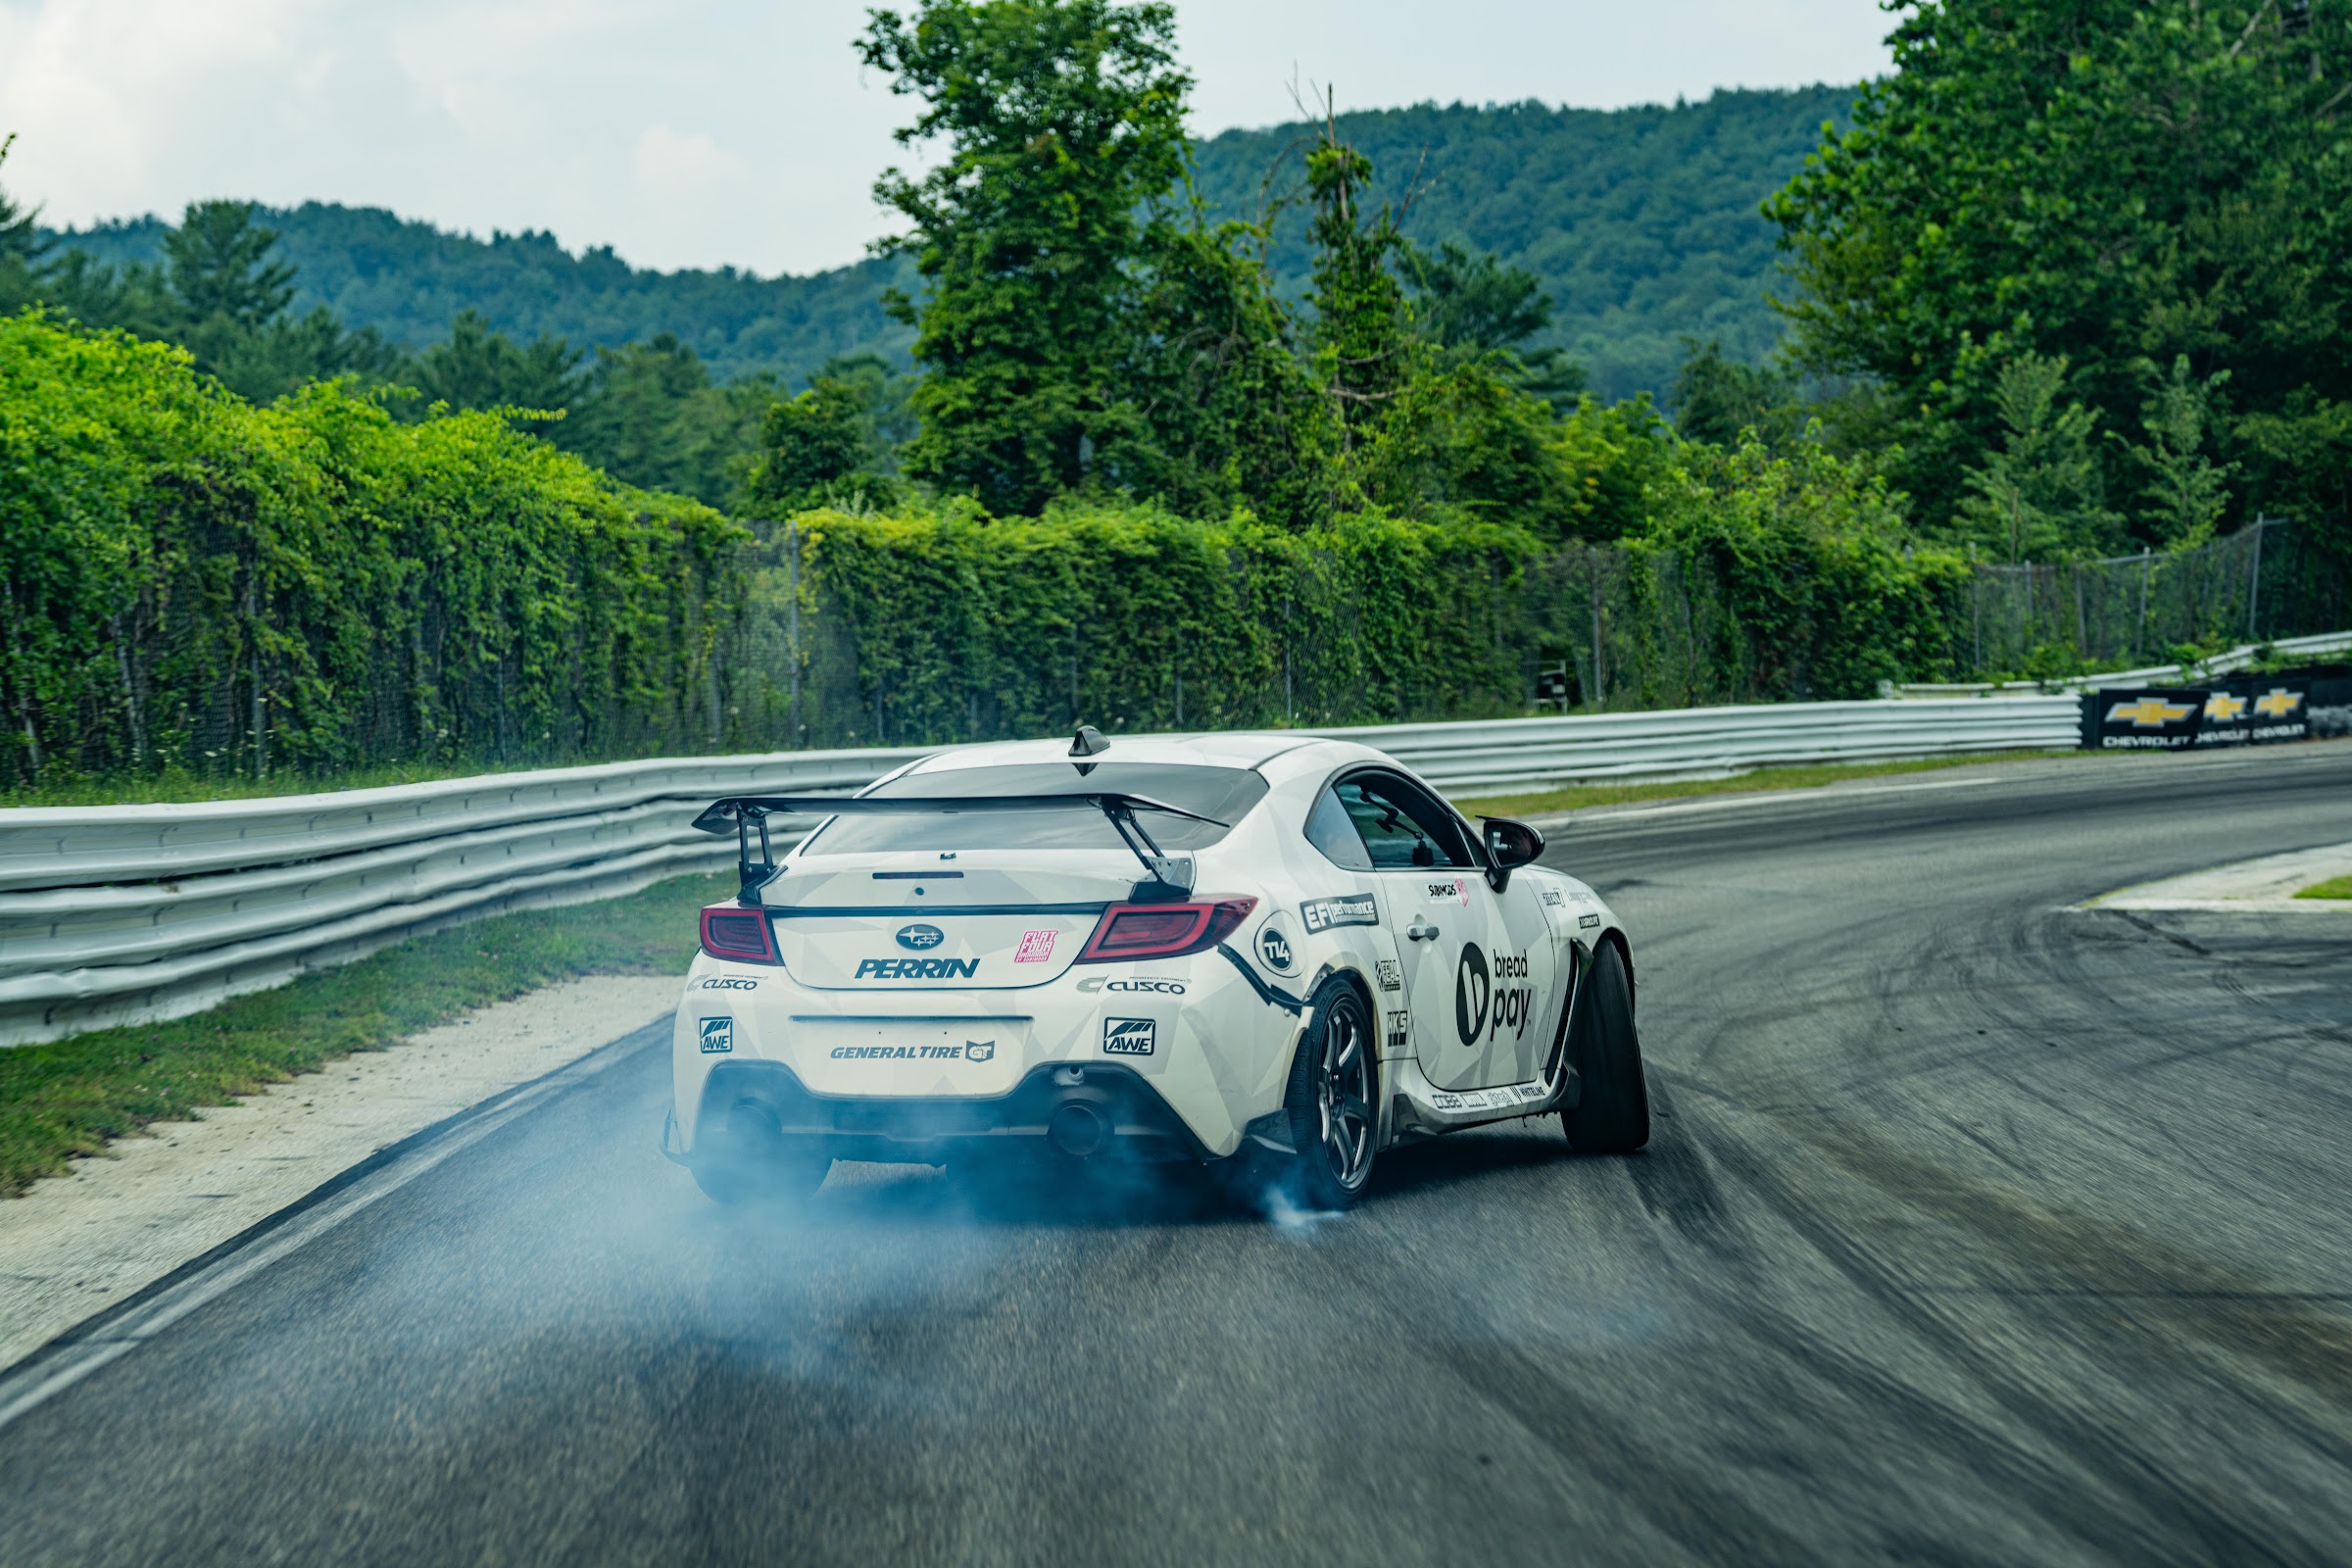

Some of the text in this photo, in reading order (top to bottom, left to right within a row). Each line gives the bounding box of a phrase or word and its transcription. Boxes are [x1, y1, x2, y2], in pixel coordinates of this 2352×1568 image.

[2253, 722, 2306, 739] CHEVROLET
[2102, 735, 2190, 748] CHEVROLET
[1303, 900, 1375, 930] EFI performance
[1023, 931, 1058, 942] FLAT
[1020, 941, 1054, 953] FOUR
[854, 958, 981, 978] PERRIN
[1493, 949, 1528, 978] bread
[1381, 959, 1399, 984] FEAL
[702, 979, 758, 990] CUSCO
[1106, 981, 1186, 995] CUSCO
[1490, 988, 1532, 1042] pay
[1388, 1010, 1407, 1038] HKS
[703, 1035, 729, 1050] AWE
[1107, 1037, 1152, 1052] AWE
[830, 1046, 916, 1059] GENERAL
[918, 1046, 963, 1059] TIRE
